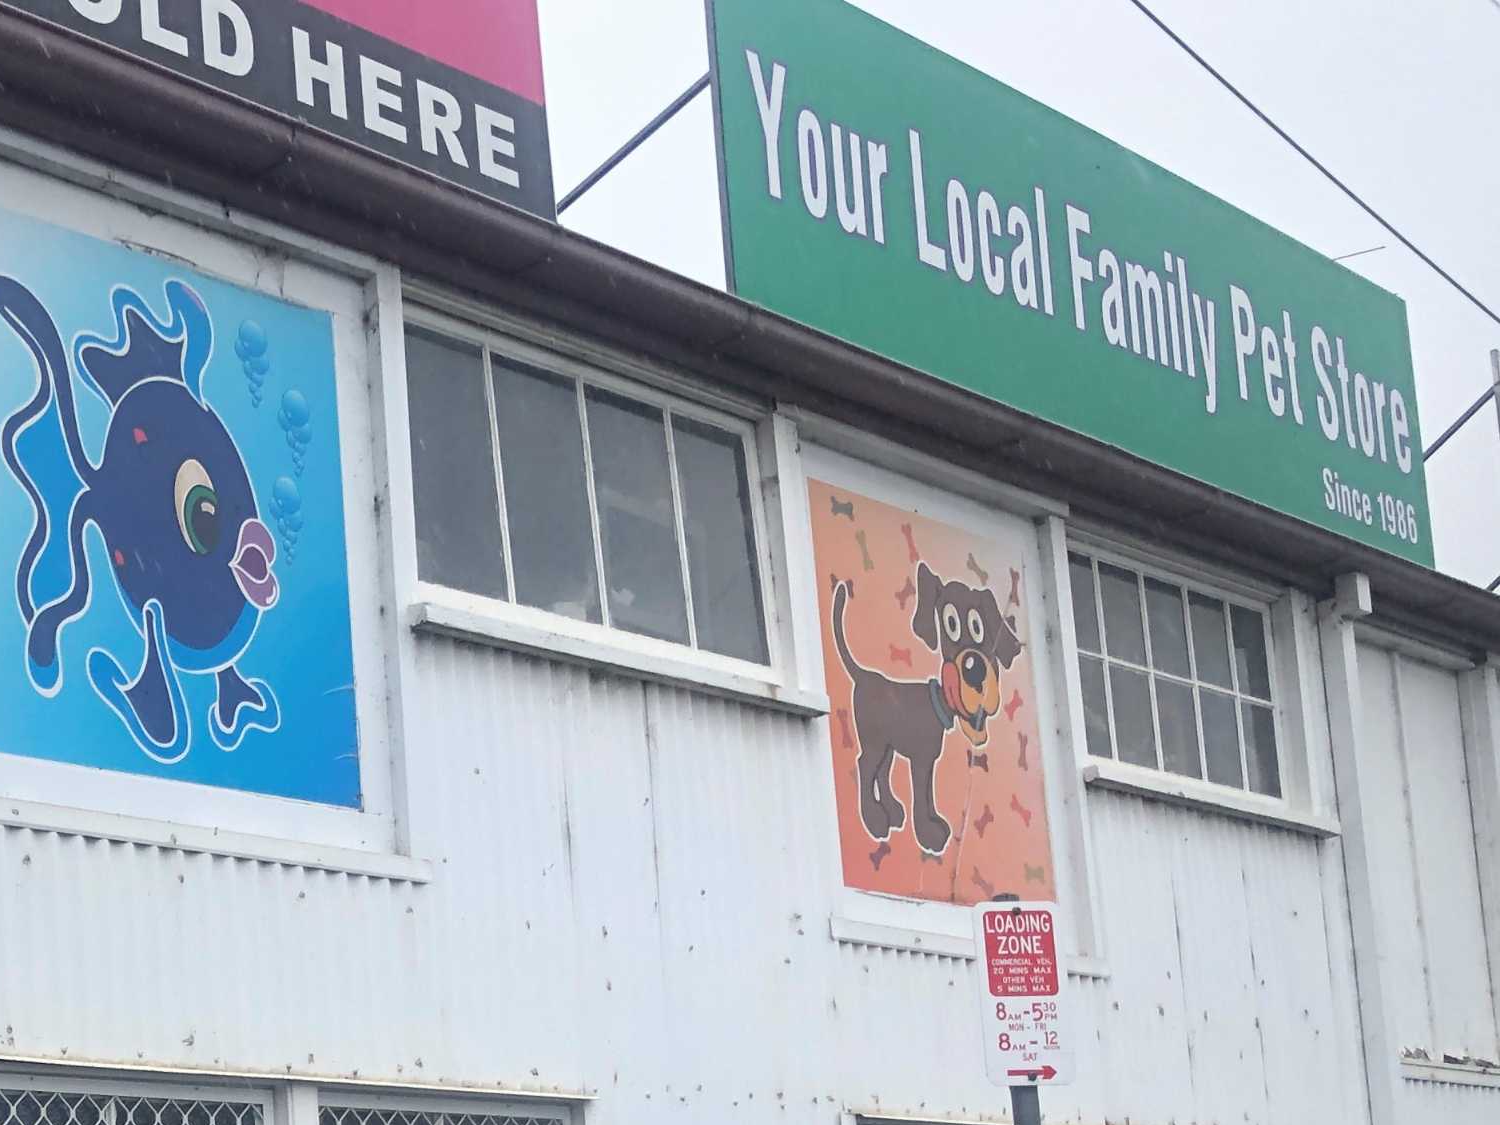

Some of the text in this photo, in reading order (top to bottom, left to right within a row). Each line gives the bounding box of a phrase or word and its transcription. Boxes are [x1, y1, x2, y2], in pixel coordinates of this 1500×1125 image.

[291, 26, 521, 189] HERE
[745, 49, 1413, 474] Your Local Family Pet Store
[1322, 467, 1419, 544] Since 1986
[985, 914, 1050, 933] LOADING
[997, 936, 1043, 954] ZONE
[1035, 1023, 1046, 1031] FRI
[1044, 1031, 1058, 1045] 12
[1023, 1053, 1037, 1061] SAT
